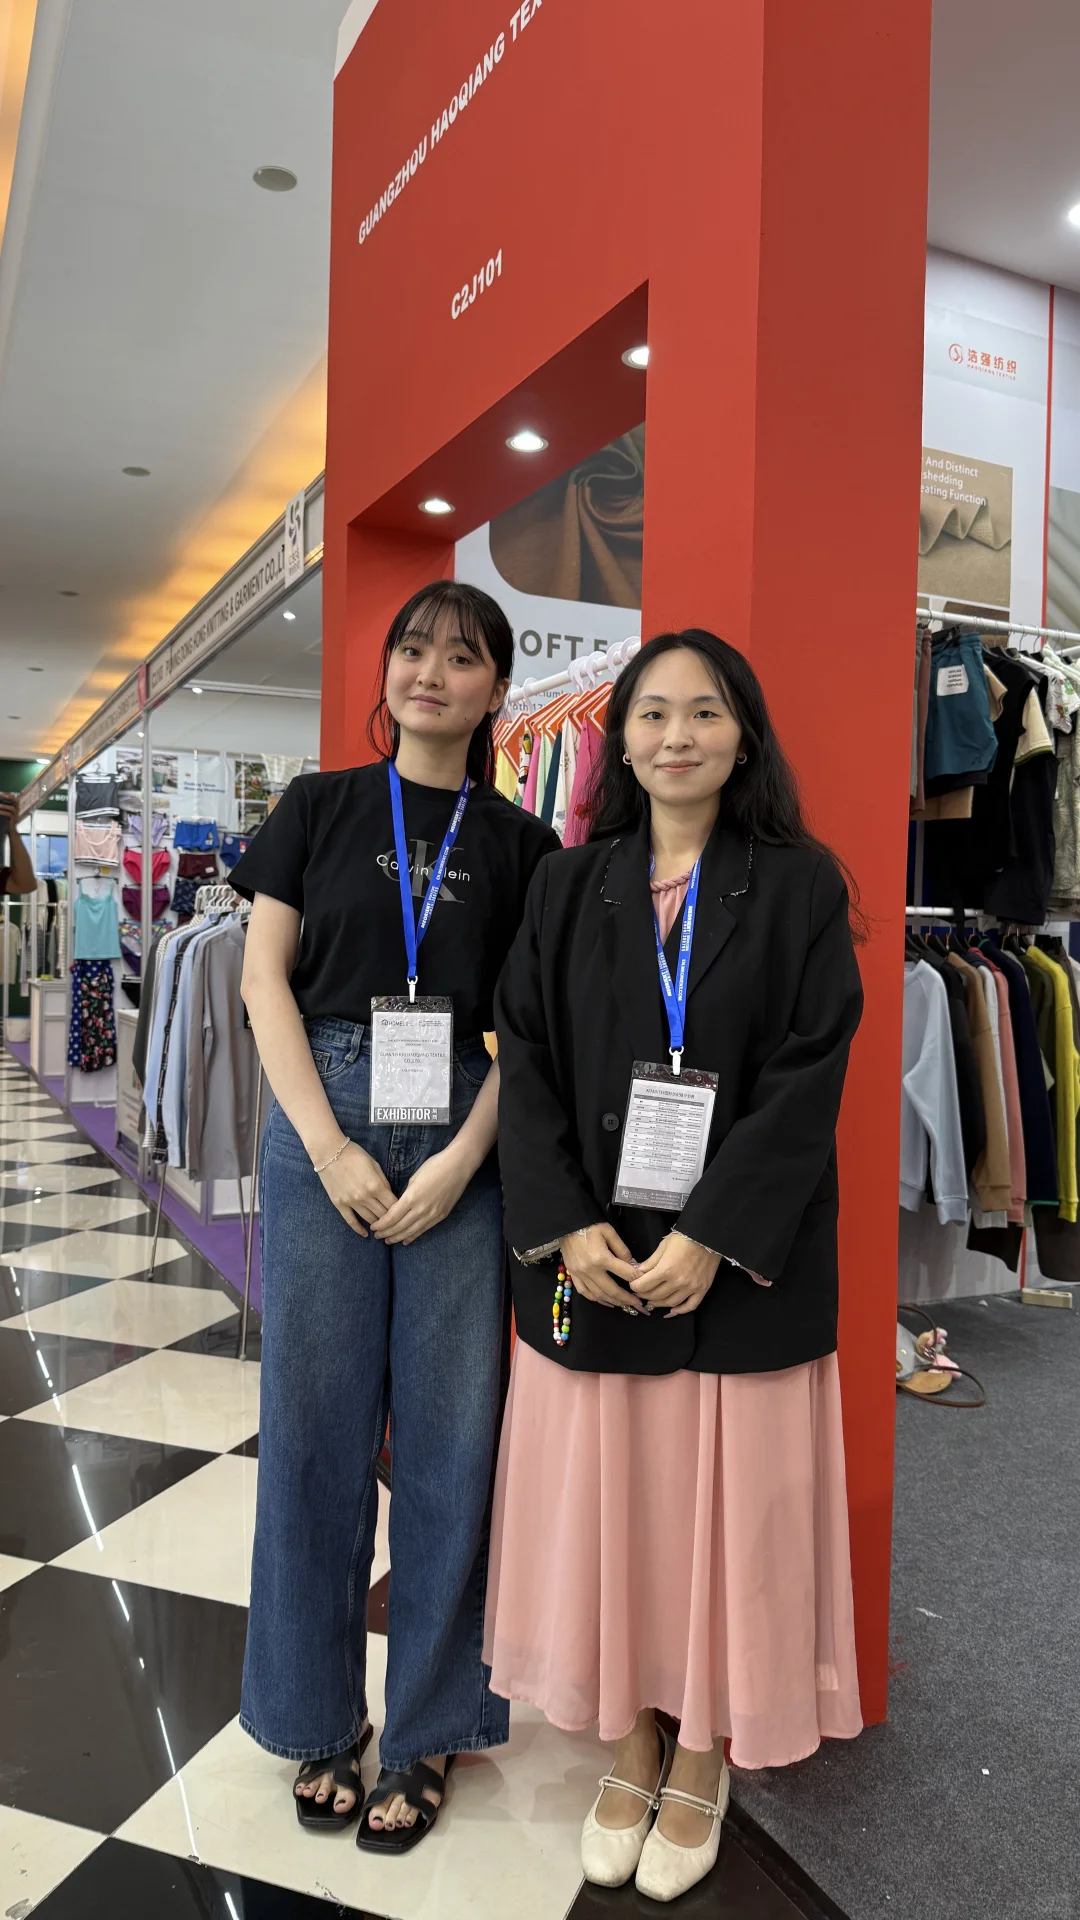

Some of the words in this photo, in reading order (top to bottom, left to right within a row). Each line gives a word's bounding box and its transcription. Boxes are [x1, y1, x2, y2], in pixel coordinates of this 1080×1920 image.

[358, 135, 428, 245] GUANGZHOU
[430, 31, 506, 150] HAOQIANG
[450, 248, 503, 320] C2J101
[925, 455, 944, 469] And
[945, 460, 978, 478] Distinct
[949, 489, 986, 507] Function
[234, 568, 264, 612] GARMENT
[519, 629, 584, 661] OFT
[376, 854, 429, 876] Cavin
[444, 867, 471, 882] lein
[376, 1107, 431, 1121] EXHIBITOR
